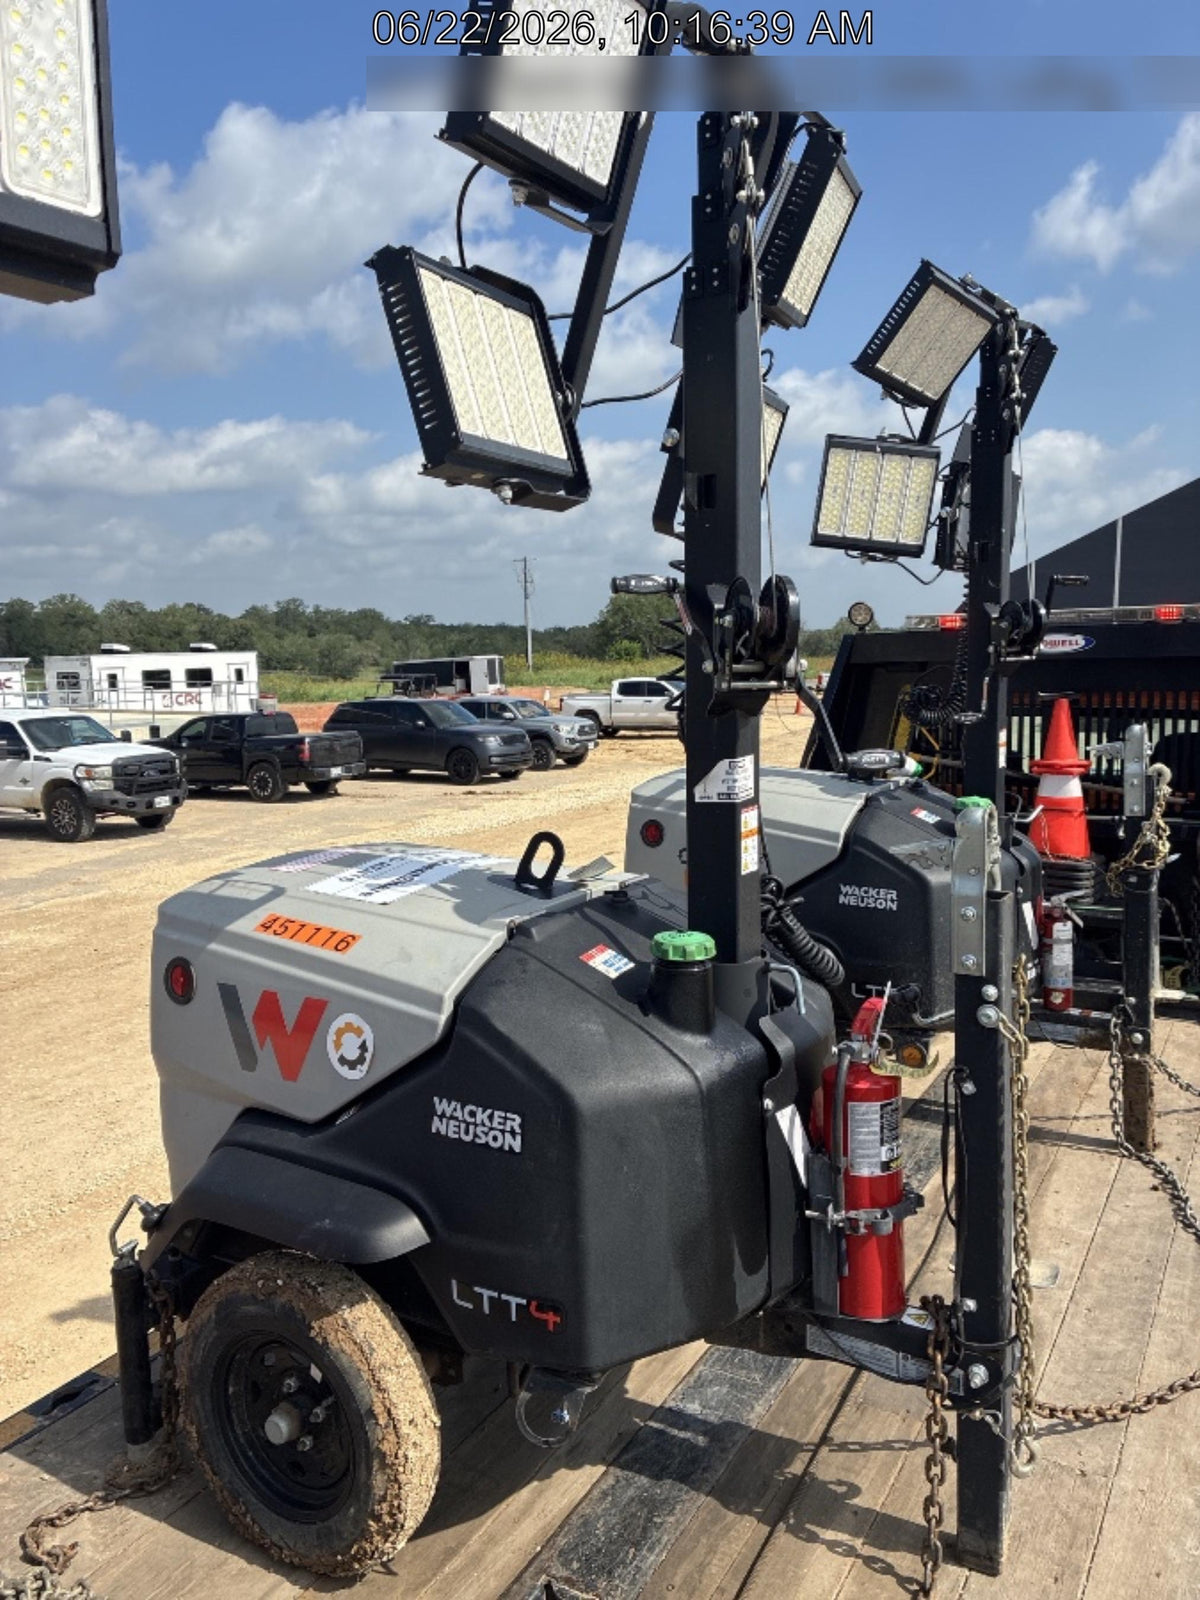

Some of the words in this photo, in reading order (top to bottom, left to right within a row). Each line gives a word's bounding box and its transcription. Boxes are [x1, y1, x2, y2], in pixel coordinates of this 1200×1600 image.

[838, 895, 898, 911] NEUSON
[839, 884, 898, 900] WACKER
[259, 916, 357, 953] 451116
[433, 1096, 522, 1134] WACKER
[431, 1116, 522, 1153] NEUSON
[451, 1279, 561, 1332] LTT4
